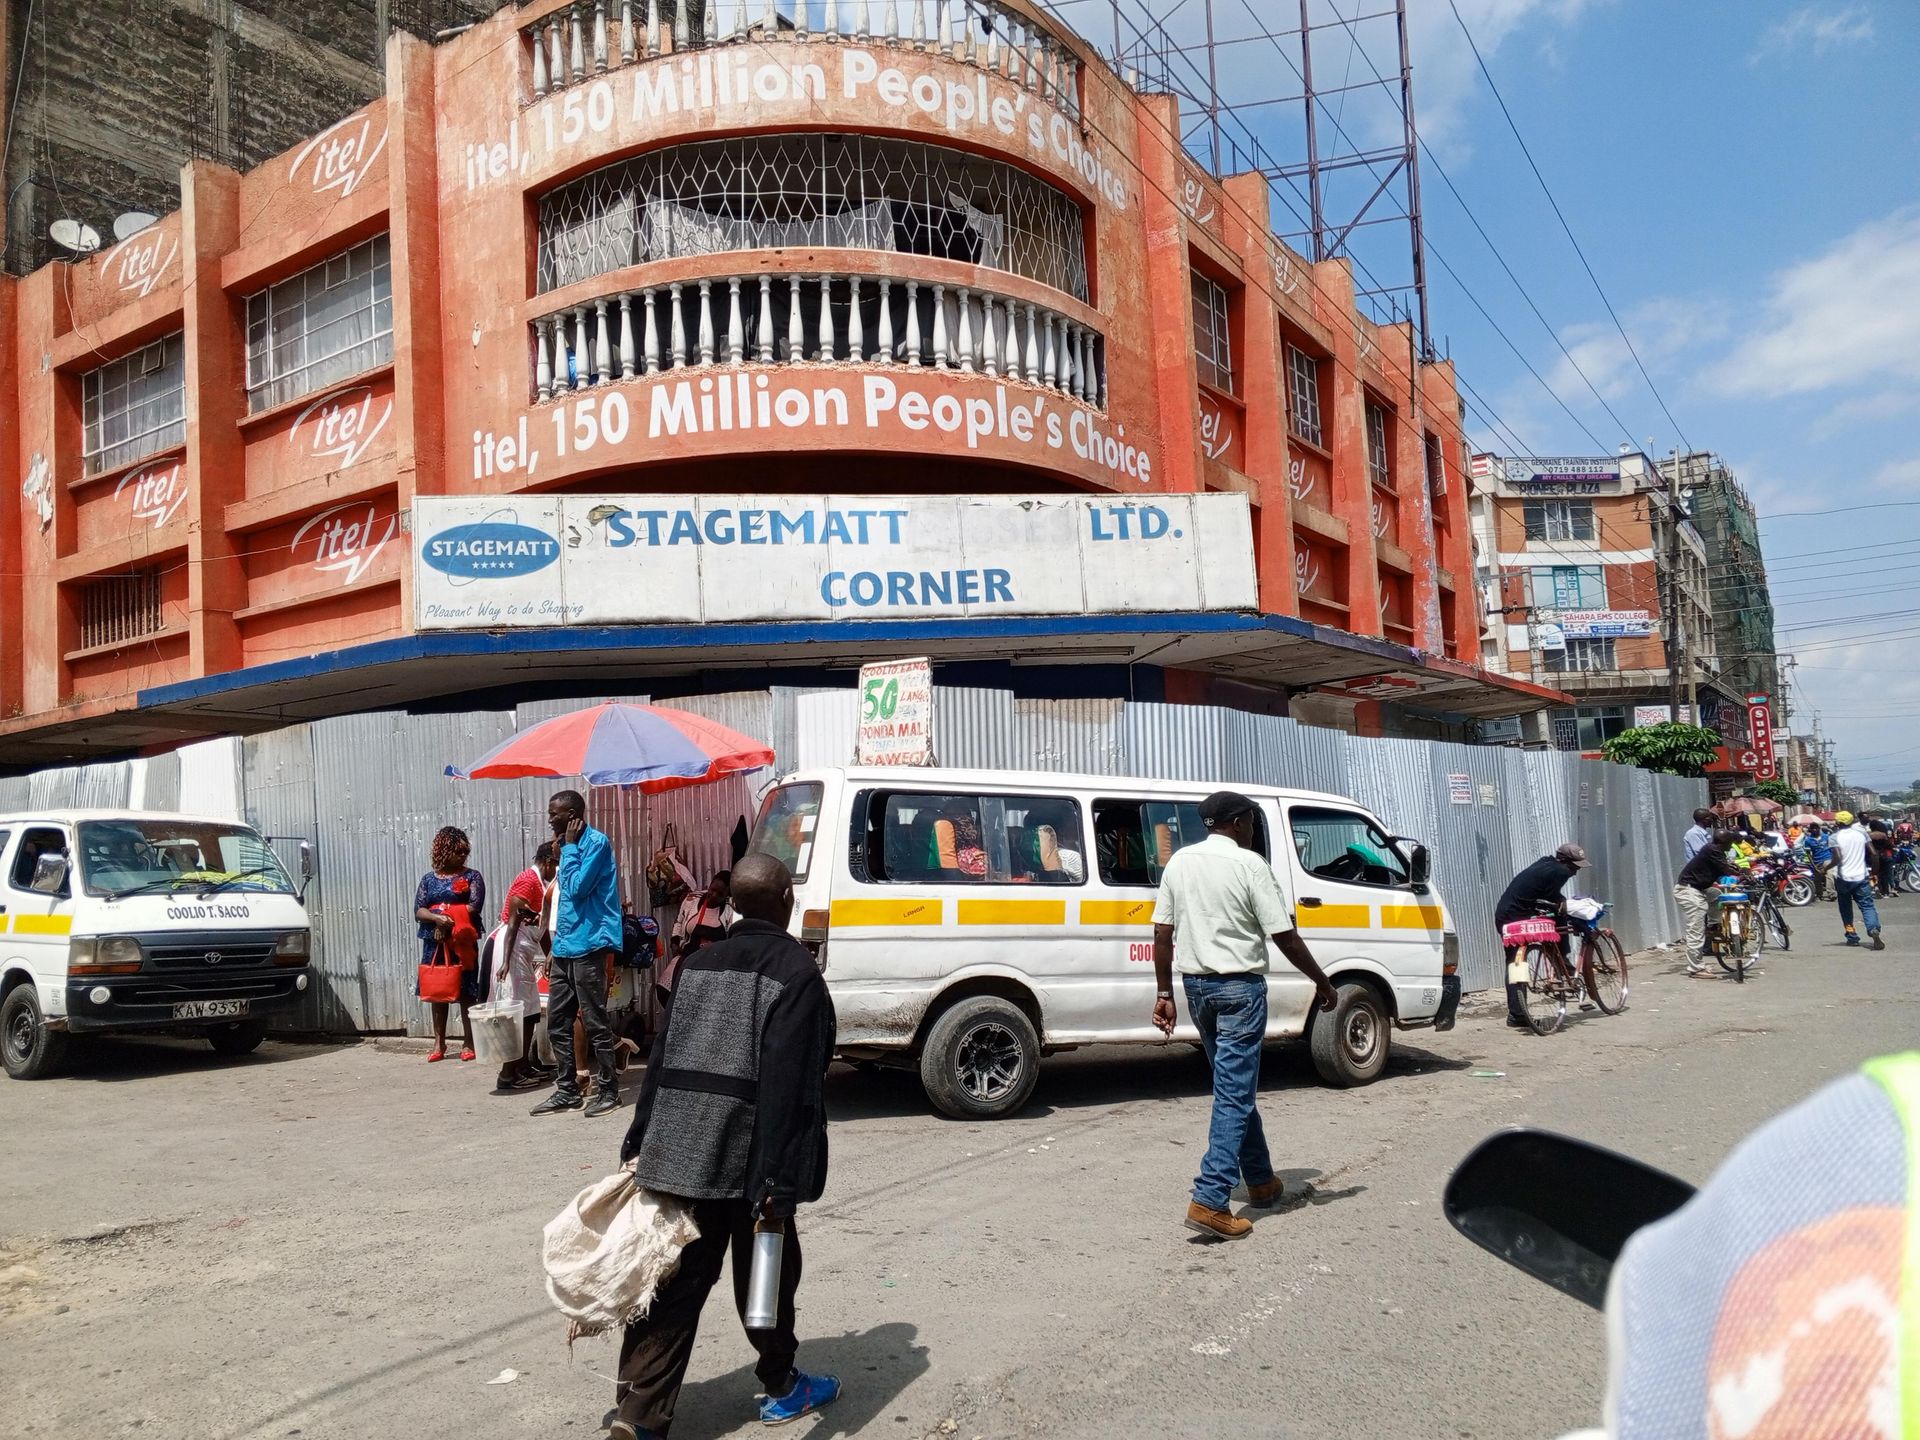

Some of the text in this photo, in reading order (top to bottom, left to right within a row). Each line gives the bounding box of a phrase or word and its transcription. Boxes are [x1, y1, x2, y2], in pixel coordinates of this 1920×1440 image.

[313, 120, 365, 185] itel
[466, 119, 531, 191] itel,
[541, 81, 614, 152] 150
[632, 50, 826, 122] Million
[1051, 112, 1127, 211] Choice
[118, 238, 160, 284] itel
[313, 400, 365, 449] itel
[472, 373, 1152, 483] itel, 150 Million People's Choice
[133, 467, 178, 514] itel
[316, 508, 373, 561] itel
[431, 540, 553, 557] STAGEMATT
[608, 506, 1183, 549] STAGEMATT LTD.
[820, 568, 1015, 607] CORNER
[425, 599, 585, 622] Pleasant Way to do Shopping
[1563, 612, 1649, 621] SAHARA EMS COLLEGE
[864, 677, 898, 721] 50
[167, 906, 206, 920] COOLIO
[218, 905, 250, 919] SACCO
[174, 1001, 205, 1019] KAW
